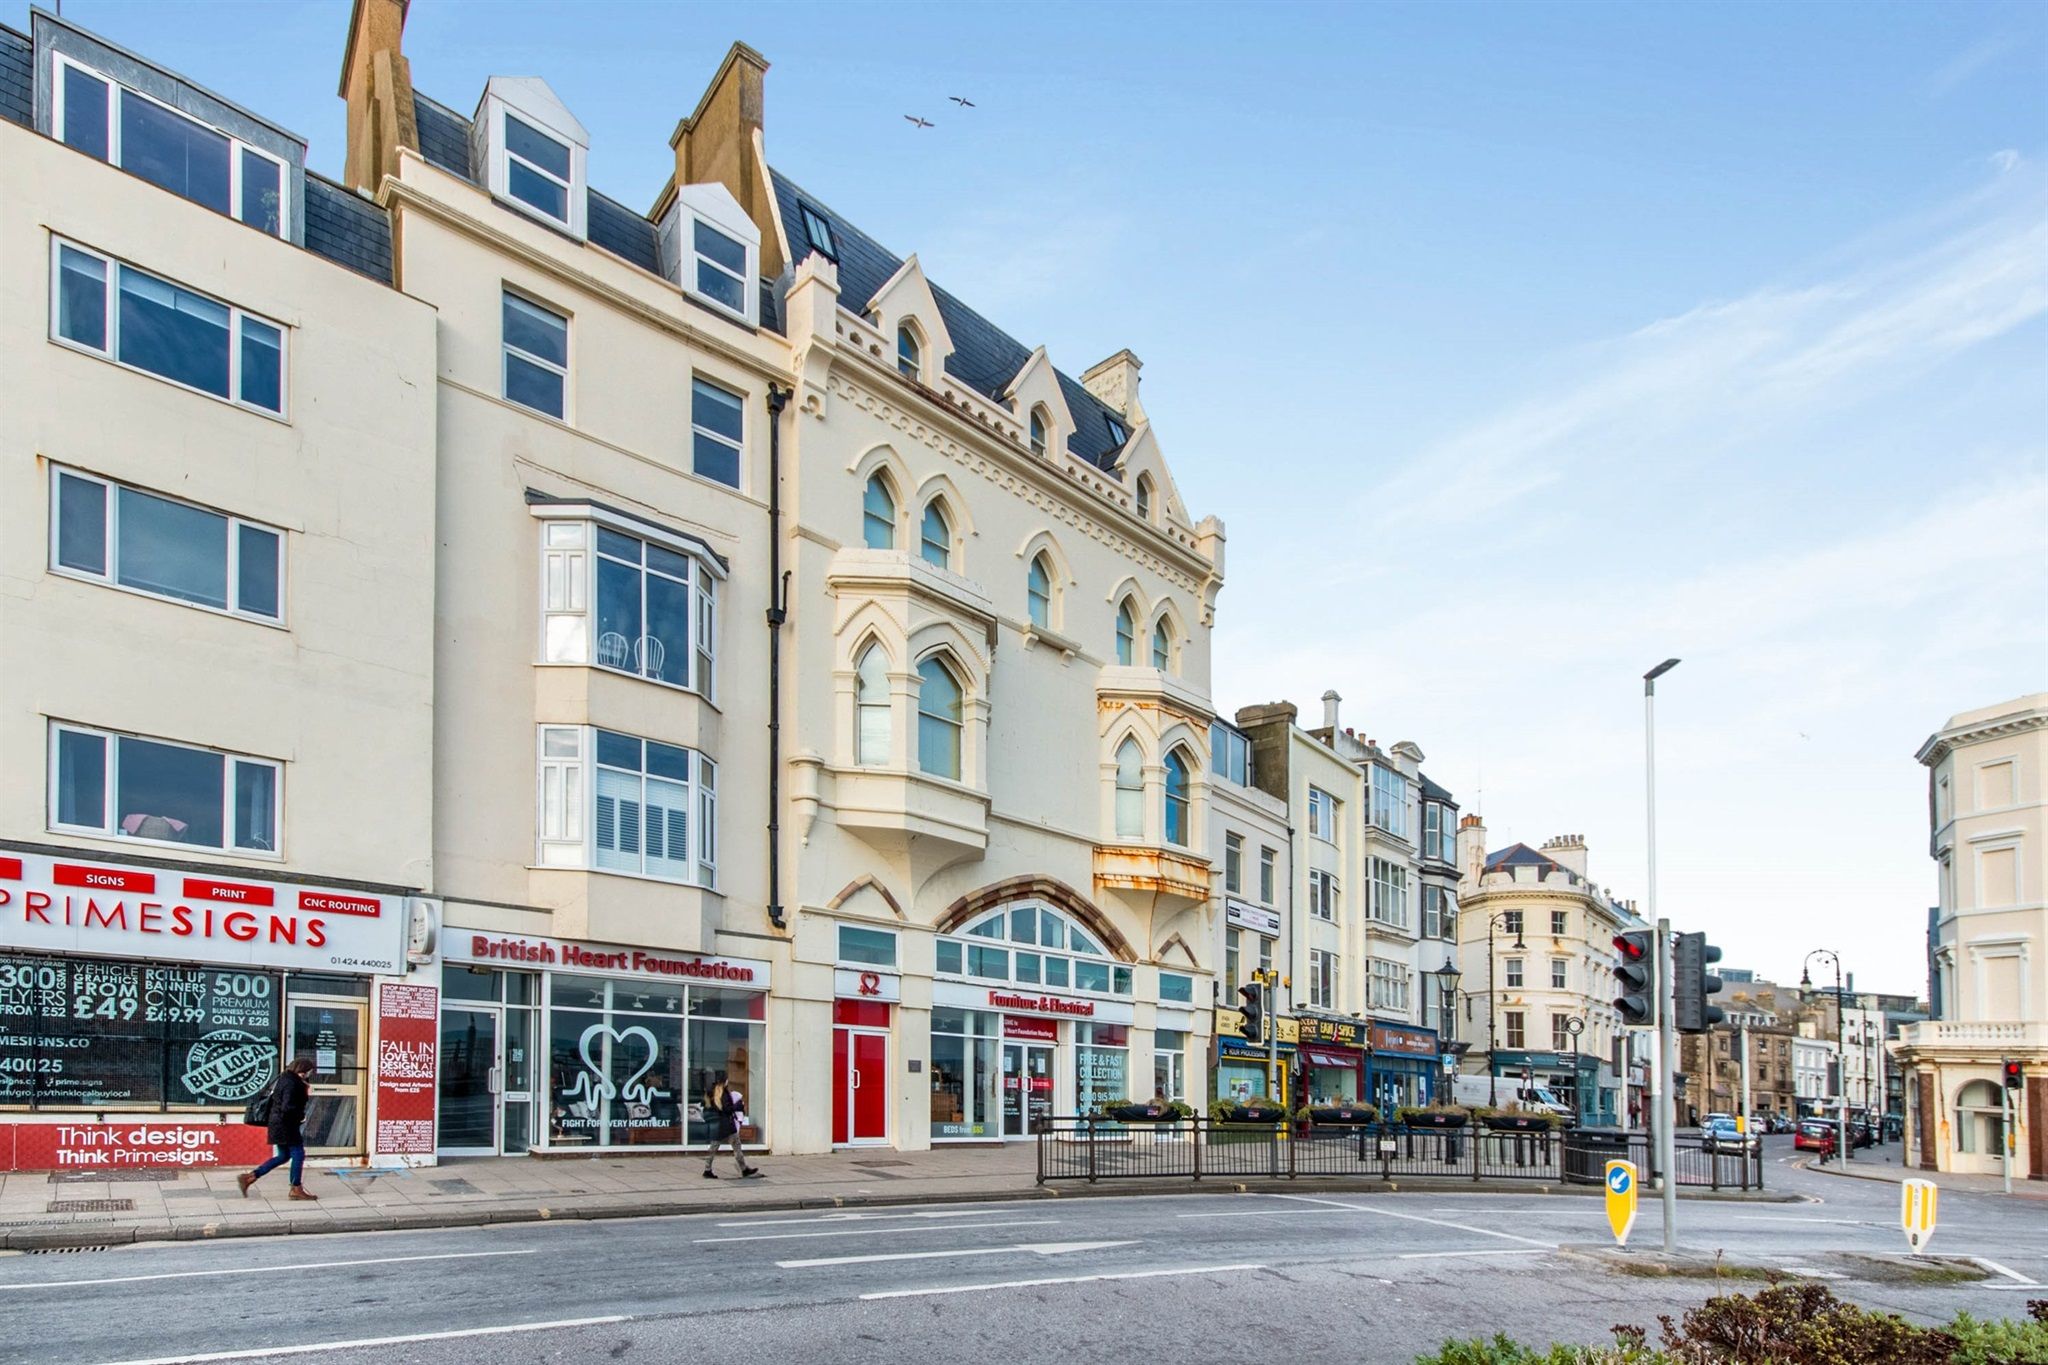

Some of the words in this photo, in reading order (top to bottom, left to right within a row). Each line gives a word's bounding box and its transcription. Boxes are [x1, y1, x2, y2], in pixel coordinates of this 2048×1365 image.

[86, 873, 125, 887] SIGNS
[212, 887, 247, 899] PRINT
[304, 898, 326, 908] CNC
[328, 900, 376, 913] ROUTING
[331, 956, 358, 966] 01424
[360, 958, 392, 968] 440025
[472, 936, 555, 963] British
[562, 945, 628, 969] Heart
[633, 952, 753, 981] Foundation
[0, 965, 55, 989] 300
[74, 963, 138, 977] VEHICLE
[145, 968, 183, 982] ROLL
[187, 971, 206, 983] UP
[74, 974, 138, 985] GRAPHICS
[145, 980, 206, 993] BANNERS
[213, 973, 270, 998] 500
[74, 981, 138, 998] FROM
[74, 995, 138, 1020] £49
[212, 996, 270, 1009] PREMIUM
[989, 991, 1037, 1009] Furniture
[1039, 996, 1049, 1012] &
[1050, 998, 1094, 1016] Electrical
[42, 1007, 66, 1017] £52
[212, 1007, 244, 1015] BUSINESS
[212, 1015, 245, 1026] ONLY
[248, 1016, 270, 1027] £28
[191, 1042, 208, 1062] BUY
[381, 1040, 414, 1053] FALL
[419, 1042, 434, 1054] IN
[381, 1053, 408, 1061] LOVE
[410, 1054, 434, 1062] WITH
[1080, 1053, 1098, 1065] FREE
[1098, 1054, 1105, 1066] &
[1106, 1055, 1123, 1067] FAST
[188, 1064, 221, 1089] BUY
[223, 1045, 273, 1073] LOCAL
[380, 1061, 418, 1070] DESIGN
[1080, 1066, 1123, 1079] COLLECTION
[380, 1070, 434, 1078] PRIMESIGNS
[217, 1088, 241, 1097] BUY
[243, 1067, 269, 1094] LOCAL
[562, 1119, 585, 1127] FIGHT
[603, 1119, 627, 1127] VERY
[629, 1119, 670, 1127] HEARTBEAT
[943, 1125, 959, 1134] BEDS
[57, 1126, 122, 1145] Think
[128, 1126, 220, 1148] design.
[57, 1149, 109, 1163] Think
[114, 1148, 219, 1165] Primesigns.
